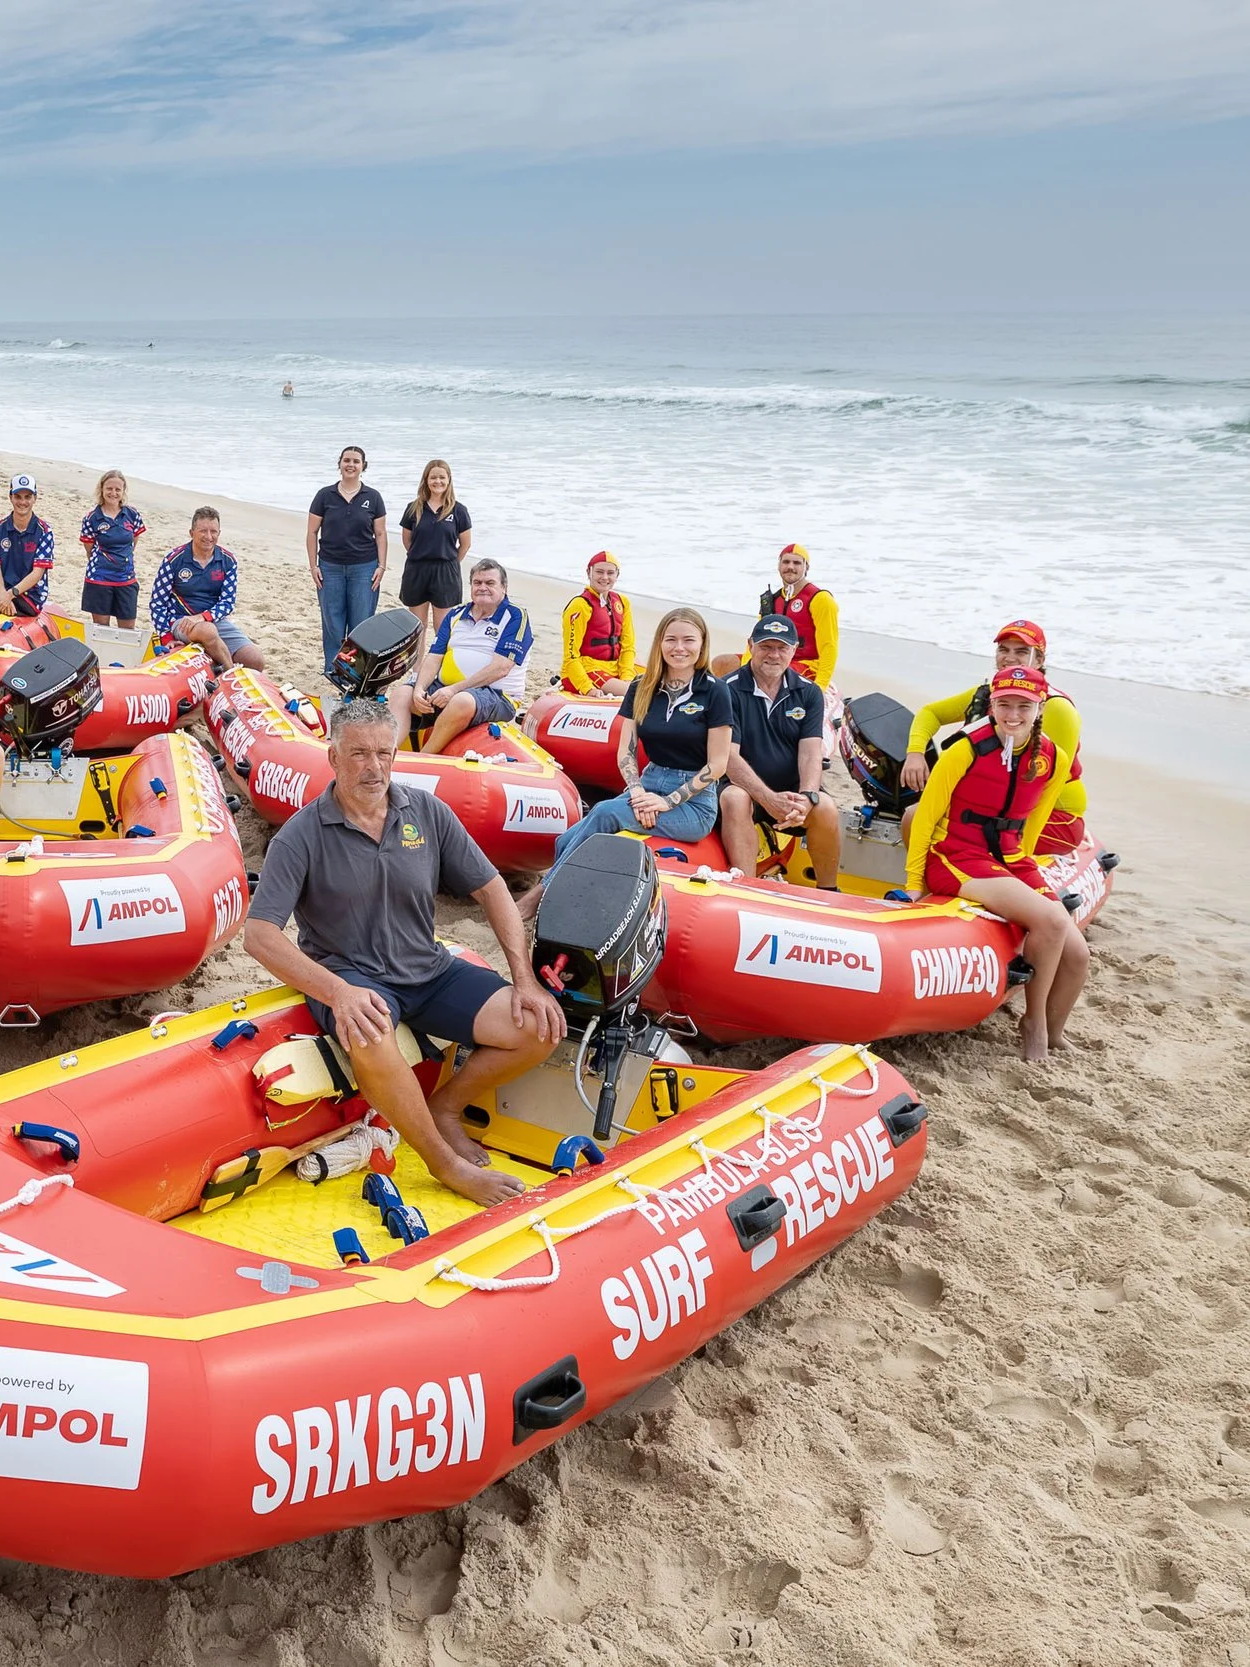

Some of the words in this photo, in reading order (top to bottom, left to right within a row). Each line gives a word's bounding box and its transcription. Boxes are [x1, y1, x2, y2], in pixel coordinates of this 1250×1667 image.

[998, 679, 1013, 688] SURF
[1013, 679, 1037, 691] RESCUE
[569, 717, 608, 730] AMPOL
[526, 805, 565, 820] AMPOL
[108, 896, 178, 921] AMPOL
[212, 875, 243, 942] 66176
[785, 945, 875, 972] AMPOL
[911, 944, 1000, 1000] CHM23Q
[769, 1114, 895, 1249] RESCUE
[601, 1230, 713, 1361] SURF
[58, 1379, 75, 1394] by
[252, 1371, 486, 1515] SRKG3N
